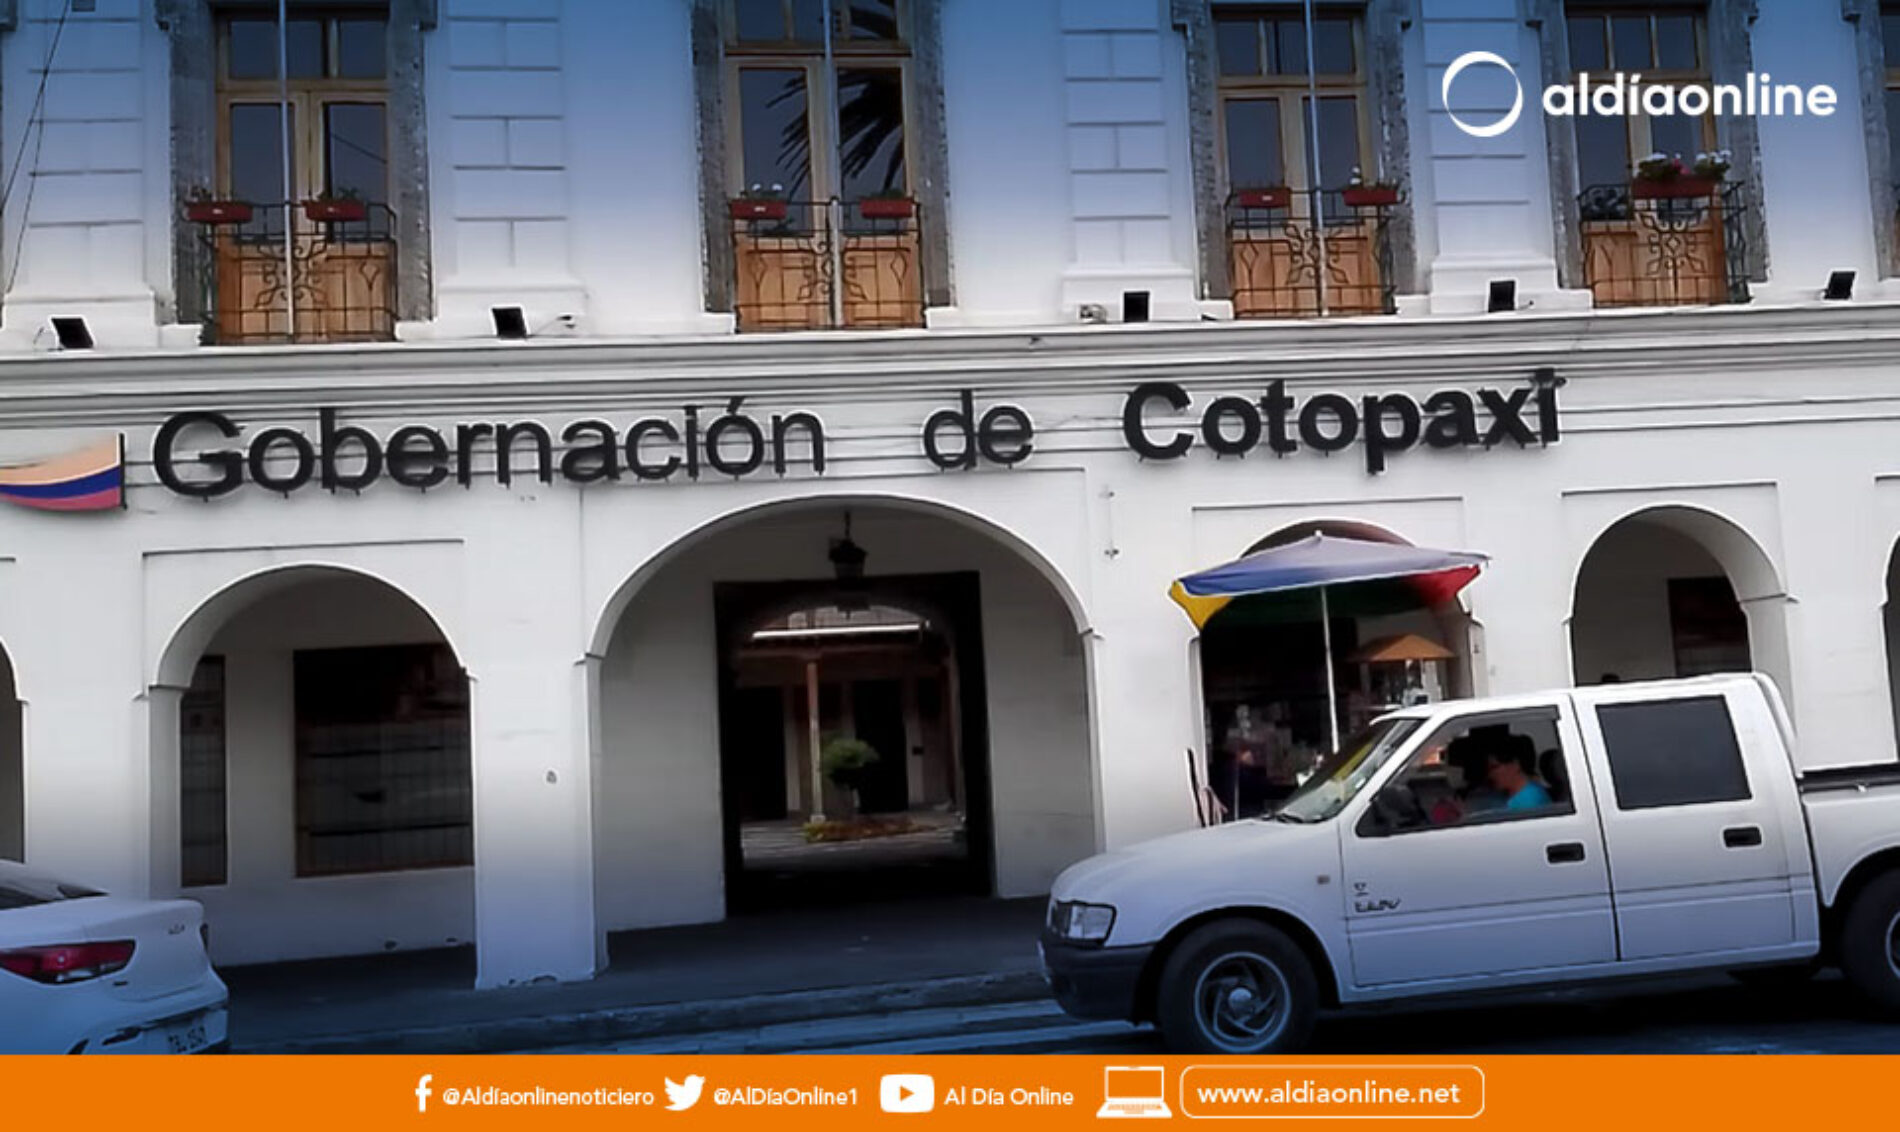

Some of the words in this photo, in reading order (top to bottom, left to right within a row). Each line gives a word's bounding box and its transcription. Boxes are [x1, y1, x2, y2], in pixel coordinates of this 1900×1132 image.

[154, 396, 825, 495] Gobernación
[923, 389, 1034, 470] de
[1123, 367, 1565, 474] Cotopaxi
